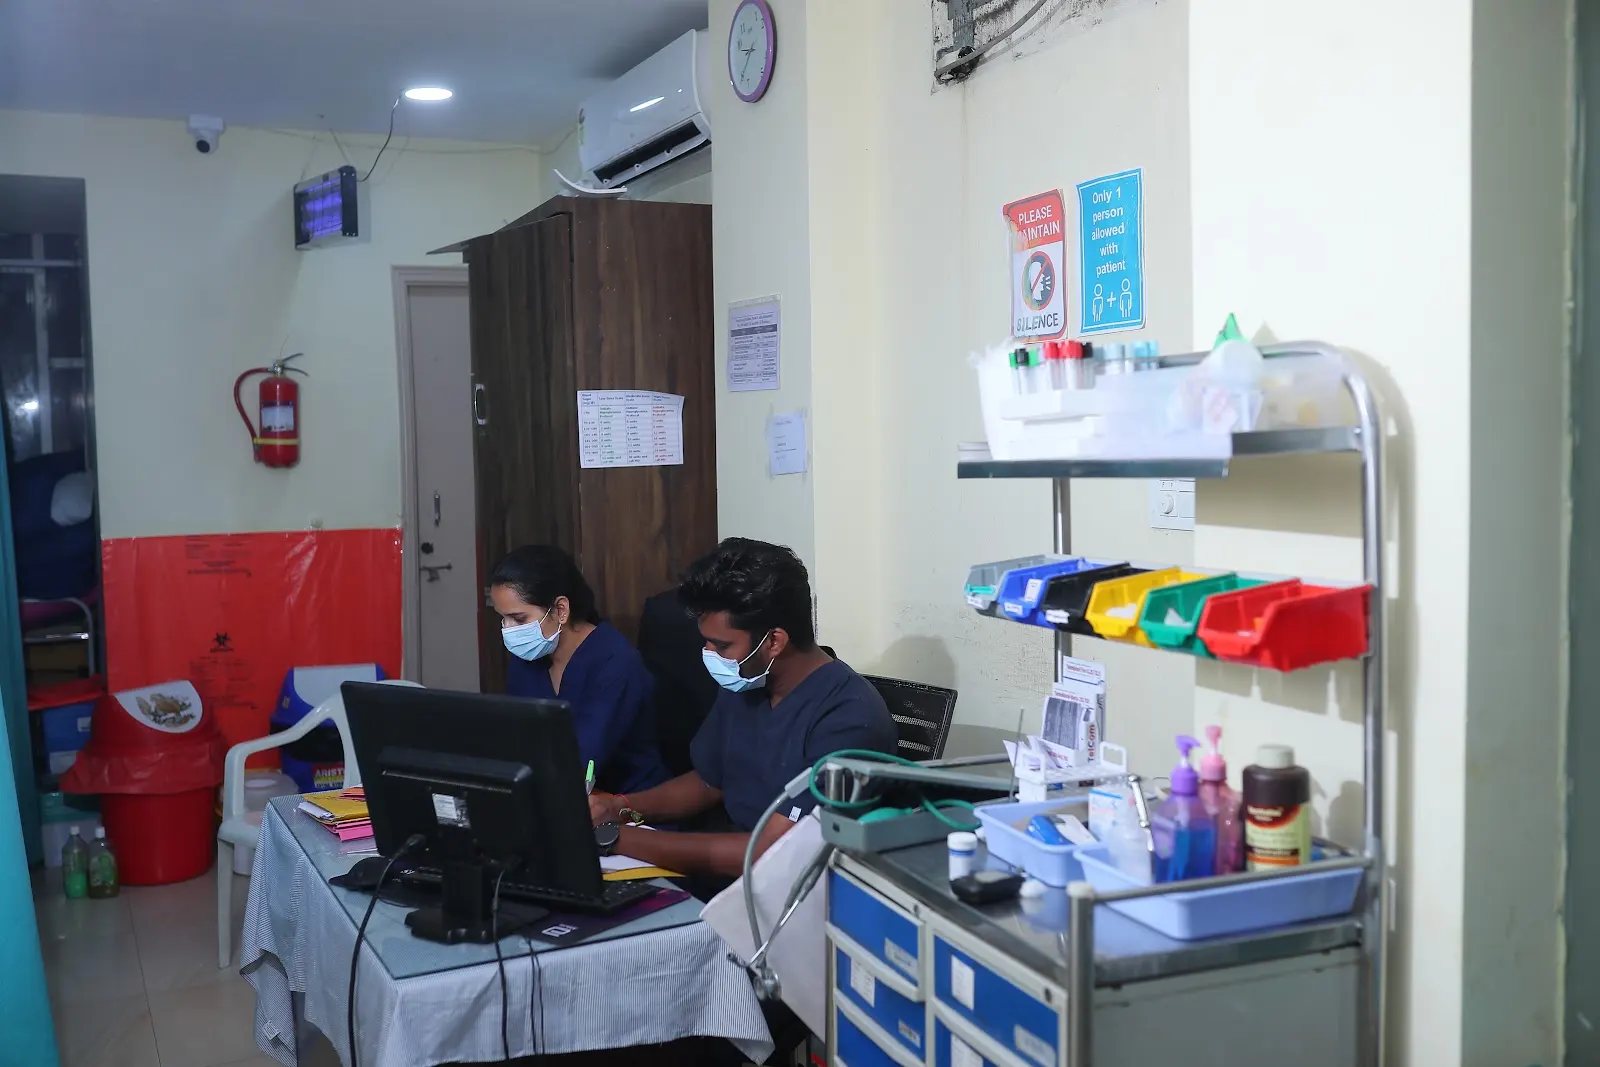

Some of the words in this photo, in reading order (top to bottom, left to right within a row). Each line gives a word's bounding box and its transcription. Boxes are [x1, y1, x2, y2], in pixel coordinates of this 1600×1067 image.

[1092, 188, 1113, 205] Only
[1115, 186, 1122, 198] 1
[1018, 204, 1053, 226] PLEASE
[1092, 206, 1124, 226] person
[1020, 219, 1060, 241] INTAIN
[1091, 221, 1126, 241] allowed
[1099, 242, 1119, 257] with
[1096, 260, 1127, 279] patient
[1016, 312, 1059, 332] SILENCE
[315, 767, 345, 777] ARIST
